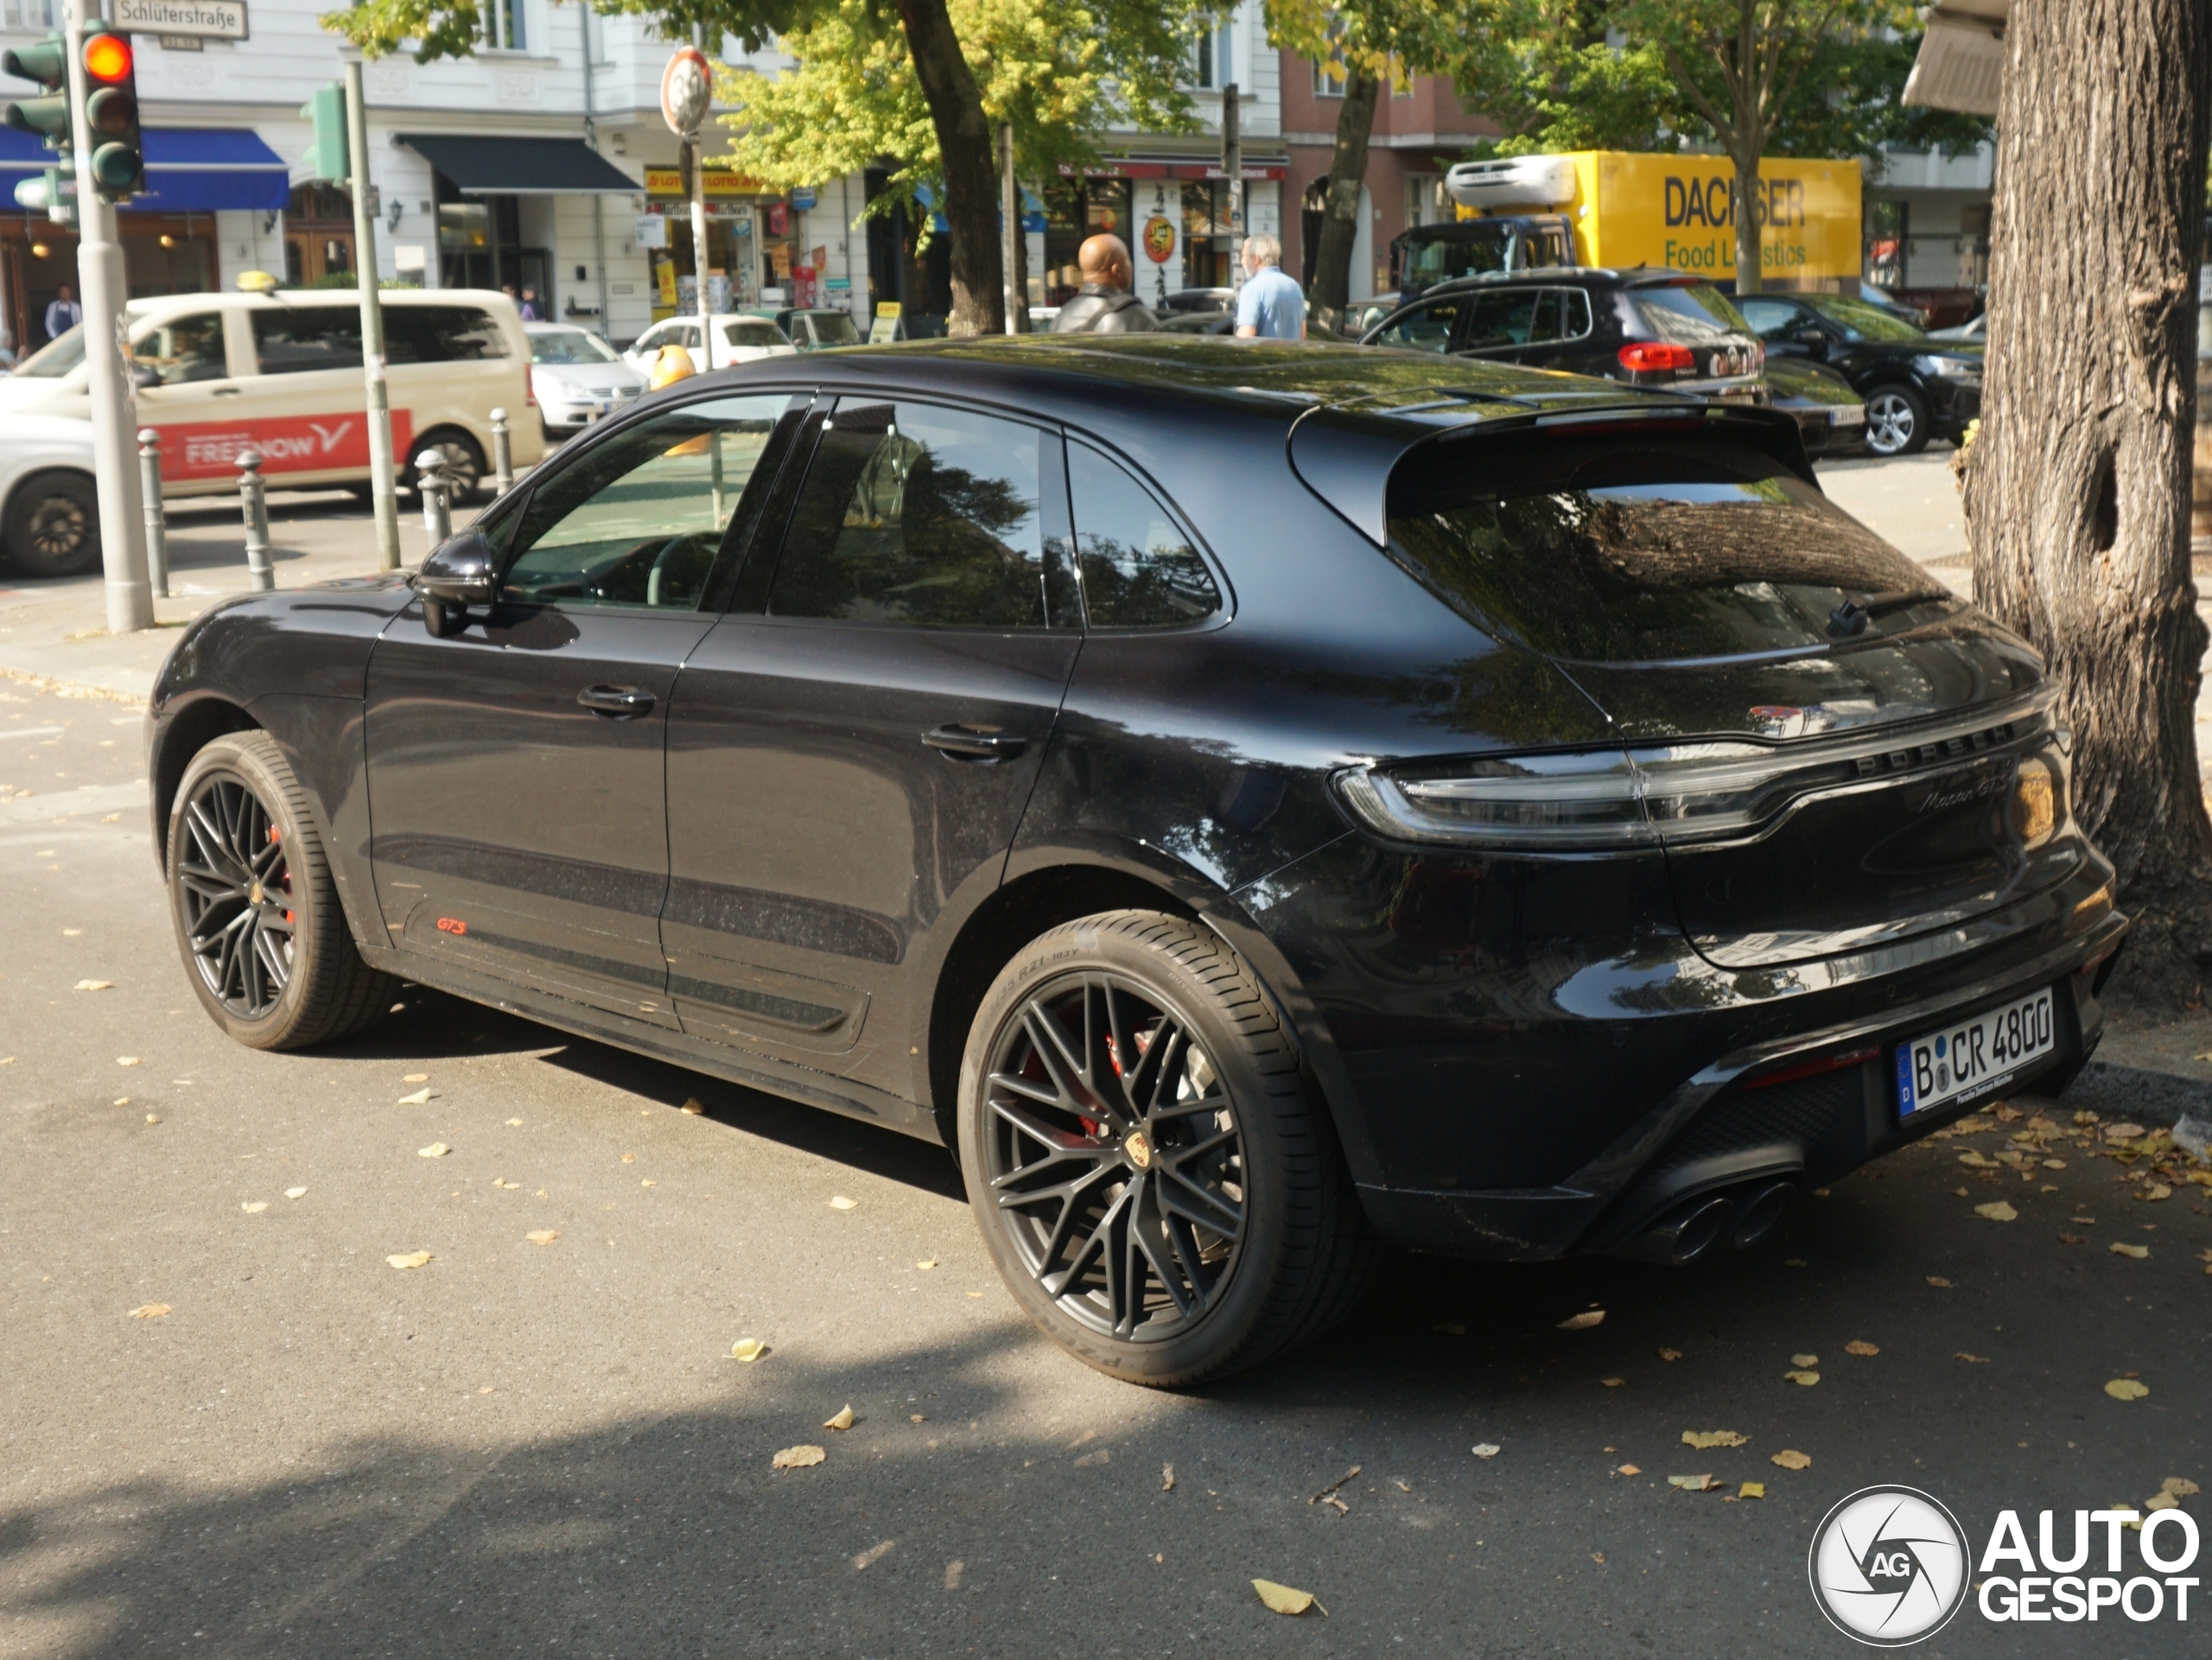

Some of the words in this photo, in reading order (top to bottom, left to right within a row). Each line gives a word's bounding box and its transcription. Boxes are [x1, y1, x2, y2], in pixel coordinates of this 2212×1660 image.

[120, 1, 236, 29] Schlüterstraße
[709, 176, 739, 188] LOTTO
[659, 202, 692, 216] Marlbor
[715, 202, 747, 216] Marlboro
[1665, 239, 1715, 268] Food
[1722, 239, 1806, 268] Lstics
[1857, 724, 2015, 776] PORSCH
[1919, 788, 1974, 814] Macan
[1976, 773, 2014, 797] GTS
[436, 917, 466, 935] GTS
[1018, 954, 1045, 982] R21
[1166, 971, 1206, 1009] OUTSIDE
[1903, 1086, 1910, 1103] D
[1915, 1045, 1935, 1101] B
[1951, 1023, 1987, 1083] CR
[1992, 995, 2051, 1065] 4800
[1956, 1088, 1977, 1106] Porsche
